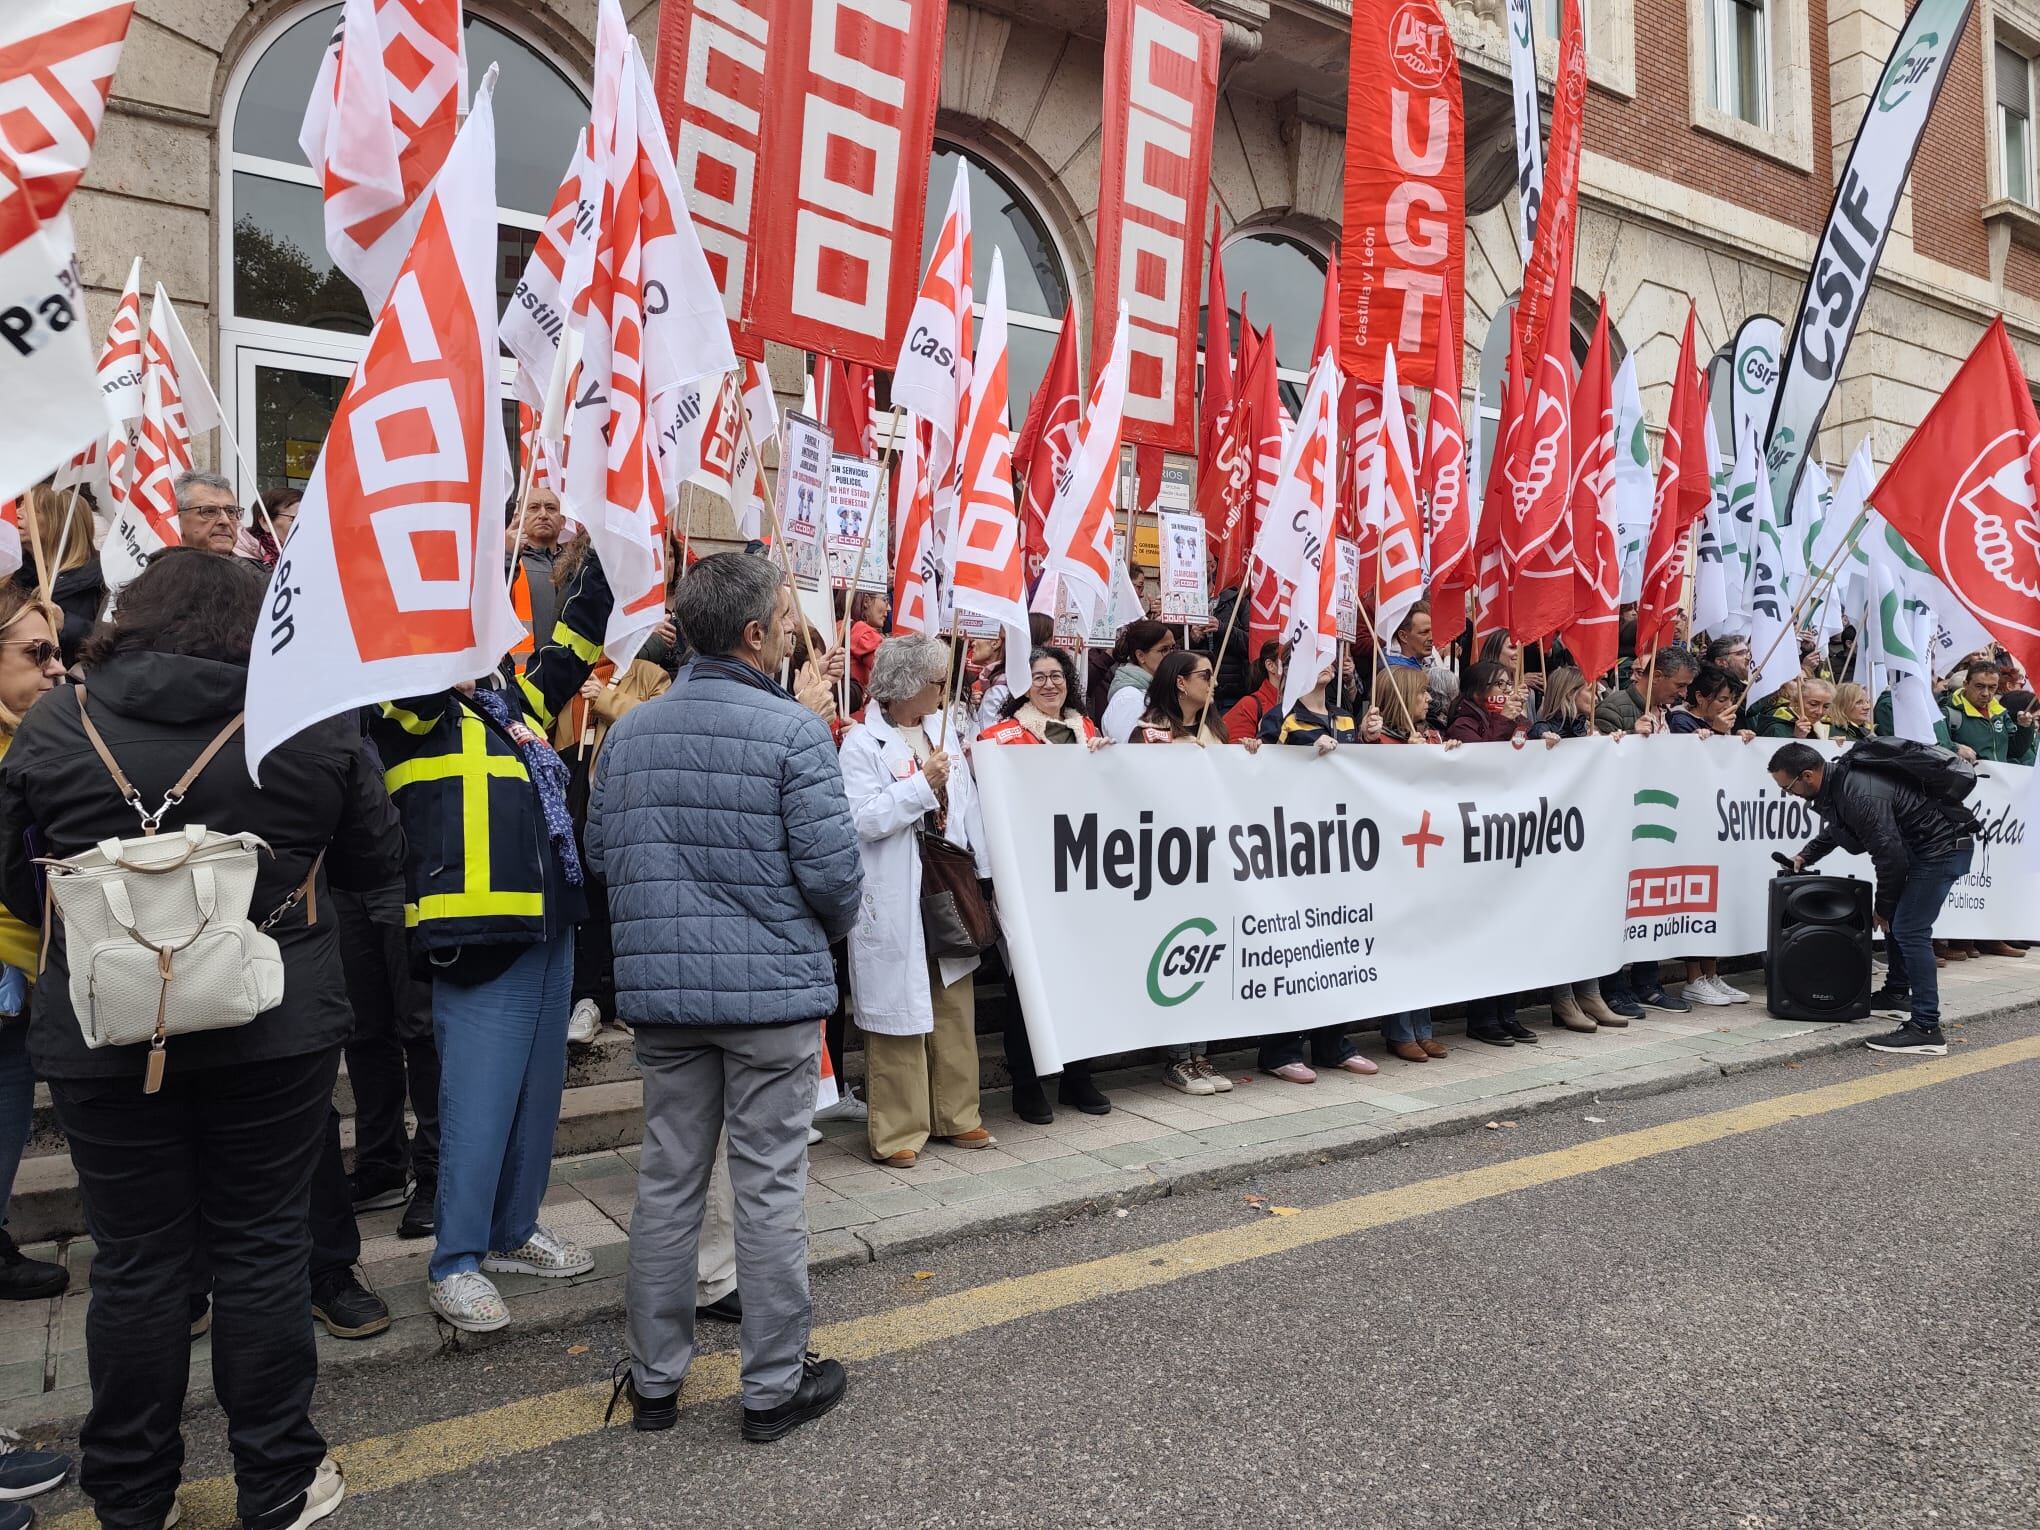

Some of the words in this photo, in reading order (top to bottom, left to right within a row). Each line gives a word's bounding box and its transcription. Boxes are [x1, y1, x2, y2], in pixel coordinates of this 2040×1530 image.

[1117, 3, 1200, 425] CCOO
[1383, 88, 1449, 353] UGT
[1362, 227, 1375, 267] León
[1363, 272, 1374, 282] y
[1800, 168, 1879, 381] CSIF
[1355, 286, 1372, 346] Castilla
[1746, 357, 1778, 387] CSIF
[831, 465, 841, 473] SIN
[842, 466, 869, 478] SERVICIOS
[839, 486, 849, 495] HAY
[271, 537, 302, 656] eón
[1716, 788, 1813, 841] Servicios
[1053, 810, 1216, 901] Mejor
[1229, 803, 1380, 882] salario
[1401, 809, 1445, 868] +
[1459, 797, 1585, 869] Empleo
[1627, 875, 1711, 910] CCOO
[1948, 892, 1985, 910] Públicos
[1241, 909, 1301, 936] Central
[1304, 902, 1373, 928] Sindical
[1653, 915, 1717, 941] pública
[1163, 943, 1227, 977] CSIF
[1241, 936, 1360, 968] Independiente
[1365, 937, 1375, 956] y
[1240, 979, 1267, 1000] de
[1274, 965, 1378, 997] Funcionarios
